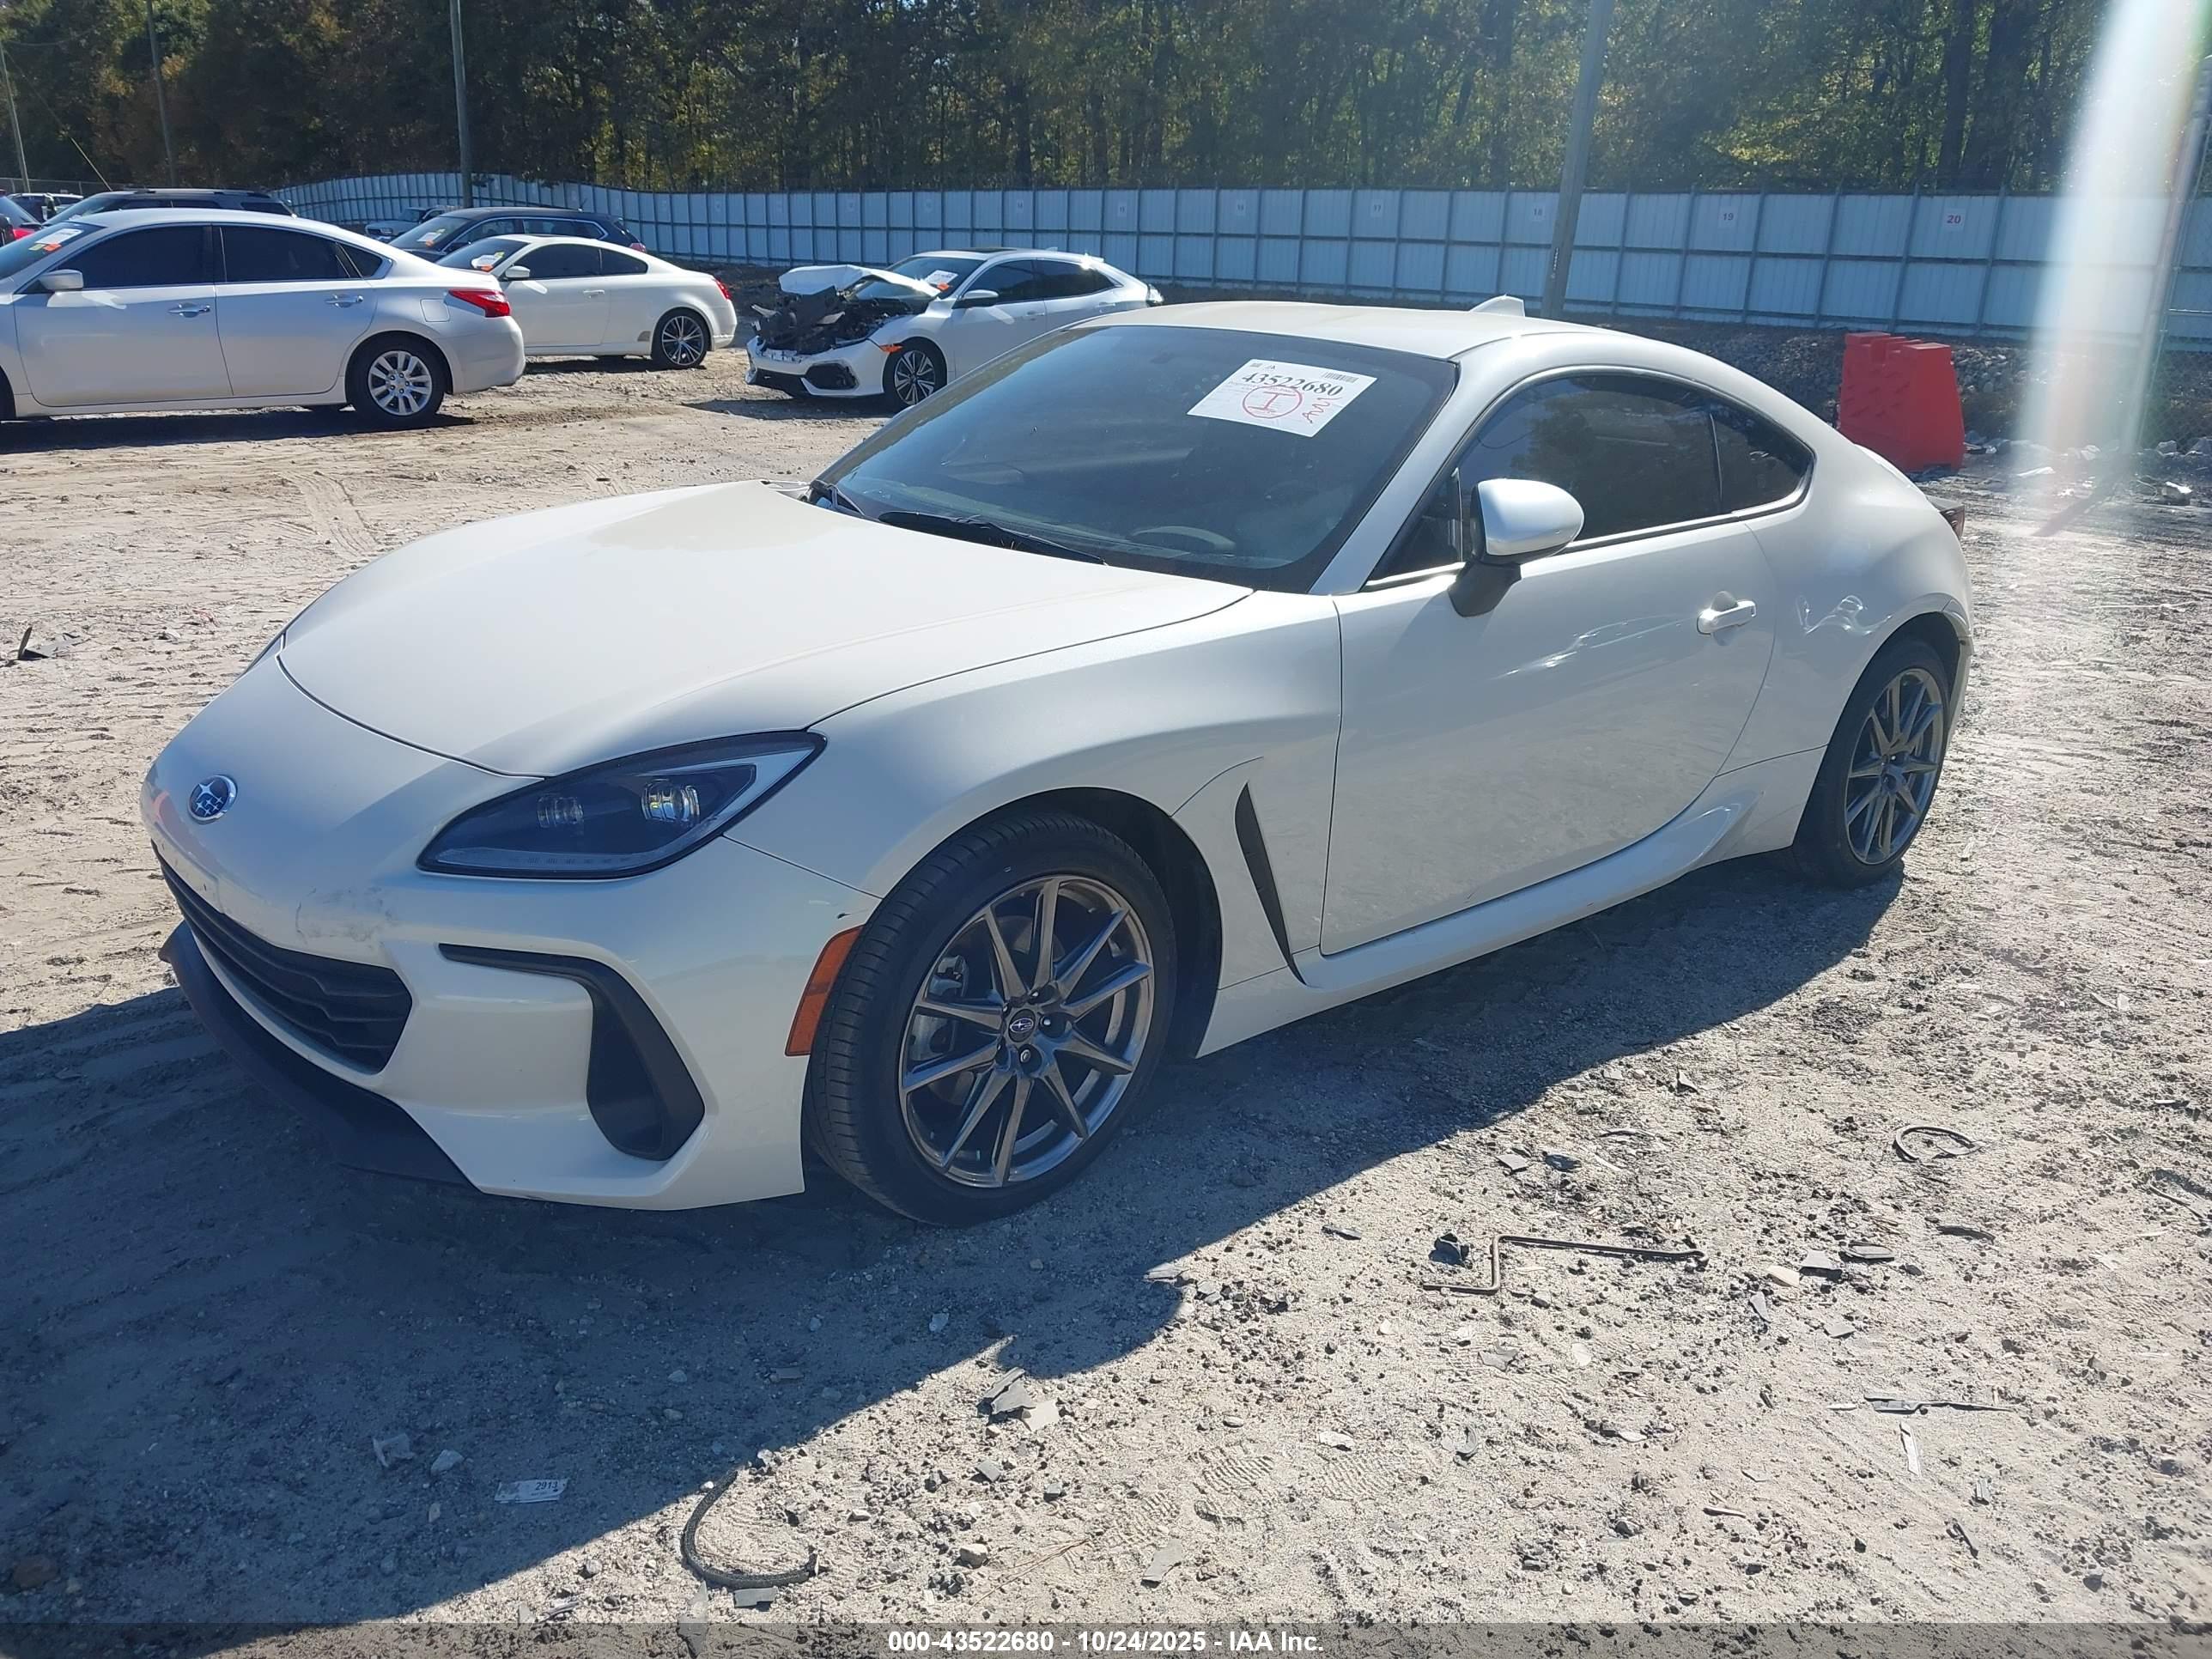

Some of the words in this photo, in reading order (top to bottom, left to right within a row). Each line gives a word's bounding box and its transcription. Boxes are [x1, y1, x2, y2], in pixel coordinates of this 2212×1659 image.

[1723, 212, 1735, 221] 19
[1947, 215, 1961, 224] 20
[1242, 372, 1344, 396] 43522680
